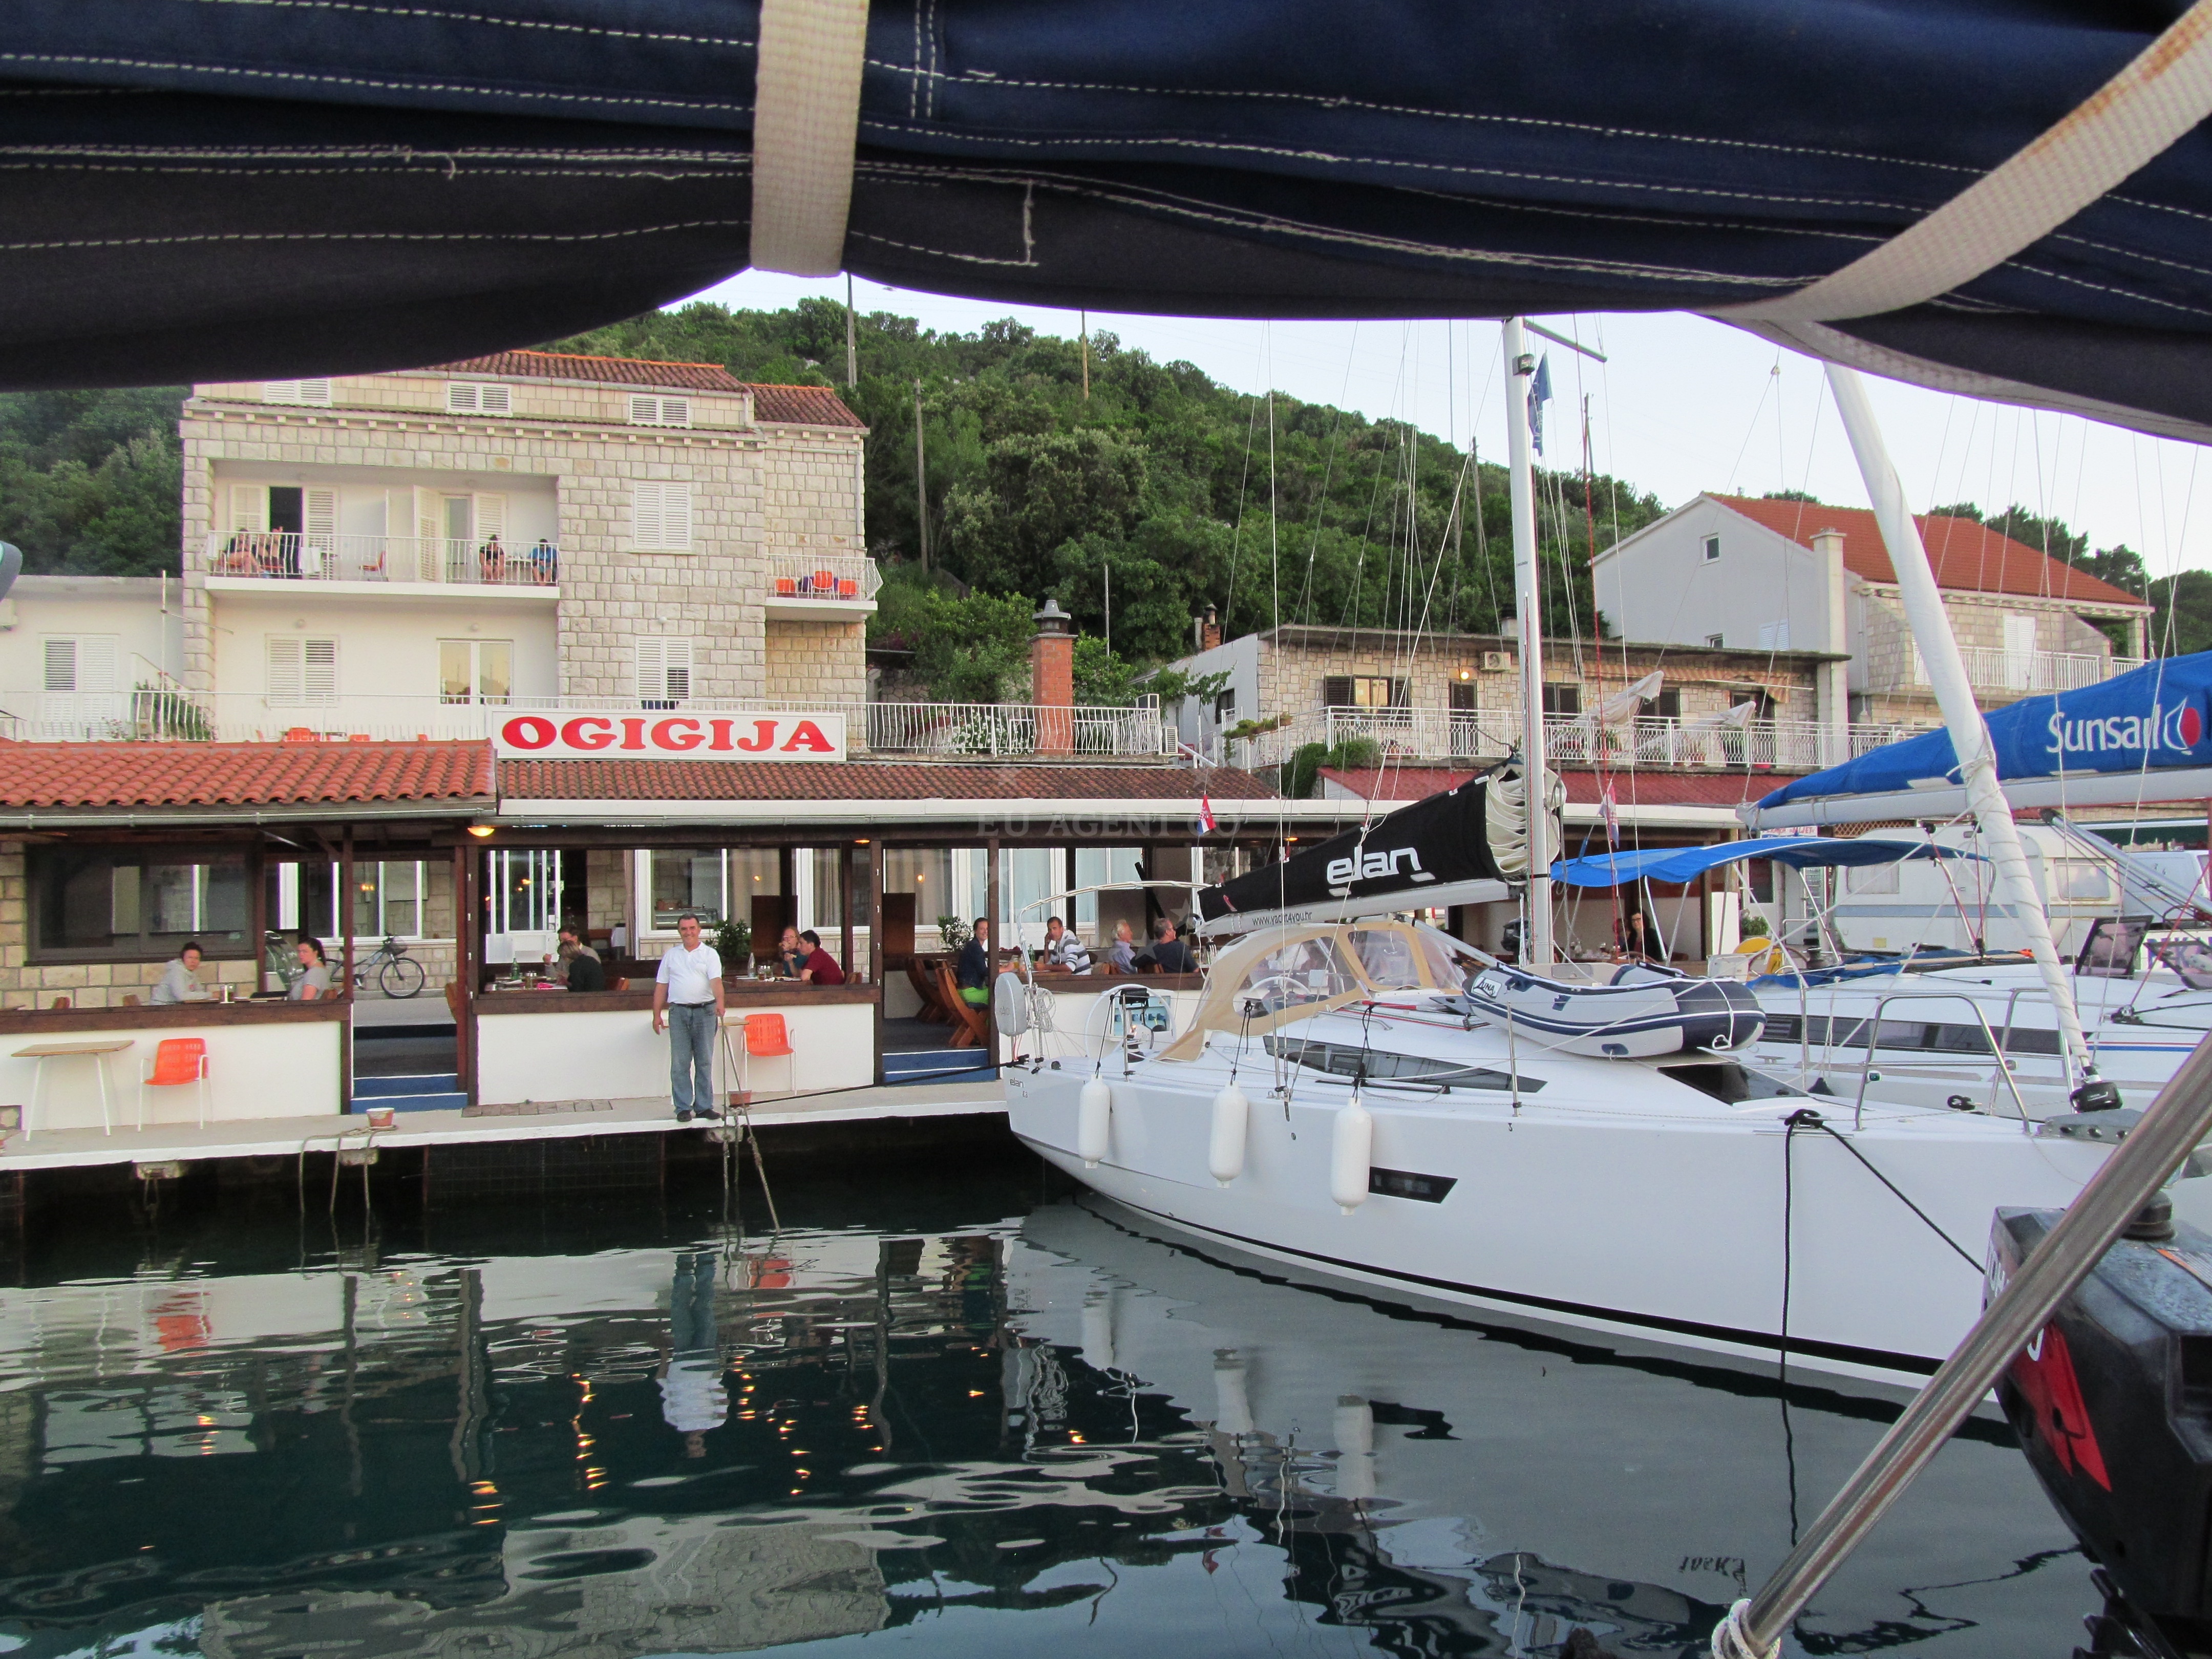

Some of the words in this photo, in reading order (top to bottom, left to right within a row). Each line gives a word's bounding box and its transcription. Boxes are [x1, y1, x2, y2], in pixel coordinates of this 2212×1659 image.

[502, 716, 836, 753] OGIGIJA
[1327, 845, 1422, 885] elan
[1252, 911, 1312, 926] www.yacht4you.hr
[1473, 977, 1497, 998] LUNA
[1010, 1077, 1024, 1088] elan
